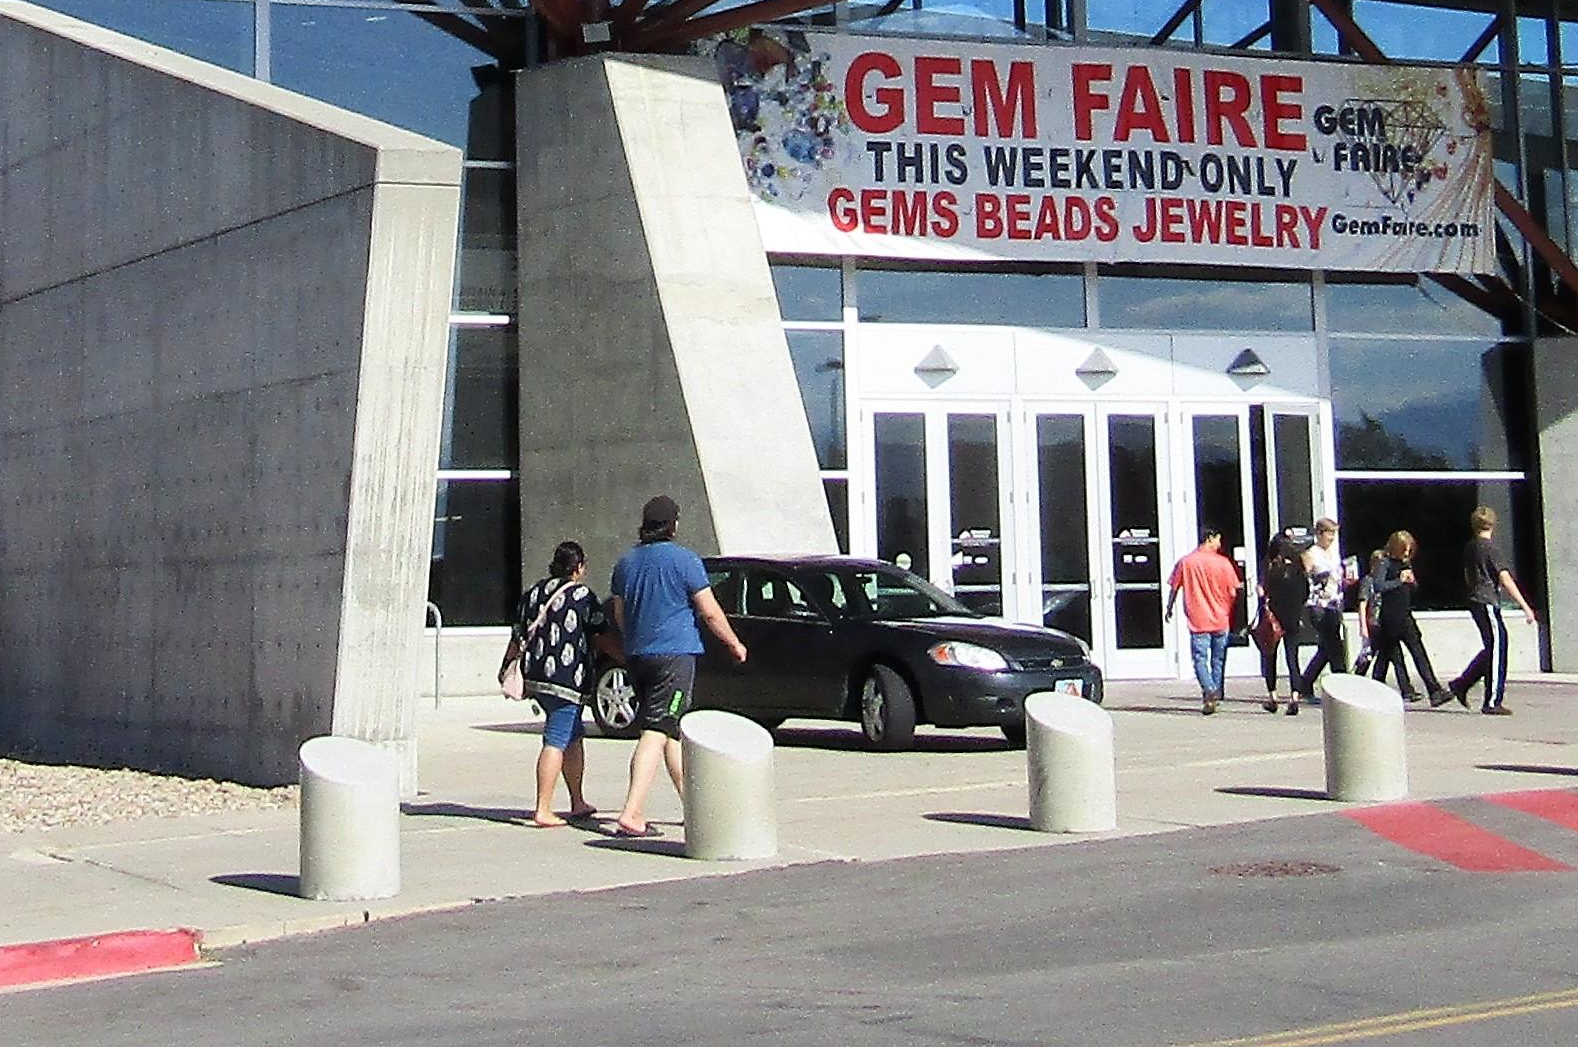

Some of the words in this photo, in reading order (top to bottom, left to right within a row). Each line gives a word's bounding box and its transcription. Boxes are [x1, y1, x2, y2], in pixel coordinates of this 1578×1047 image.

[843, 52, 1037, 140] GEM
[1071, 63, 1309, 151] FAIRE
[1314, 105, 1386, 142] GEM
[865, 140, 968, 186] THIS
[983, 145, 1181, 191] WEEKEND
[1198, 152, 1298, 199] ONLY
[1333, 141, 1423, 173] FAIRE
[828, 188, 959, 239] GEMS
[975, 194, 1120, 242] BEADS
[1132, 198, 1329, 250] JEWELRY
[1331, 213, 1480, 239] GemFaire.com
